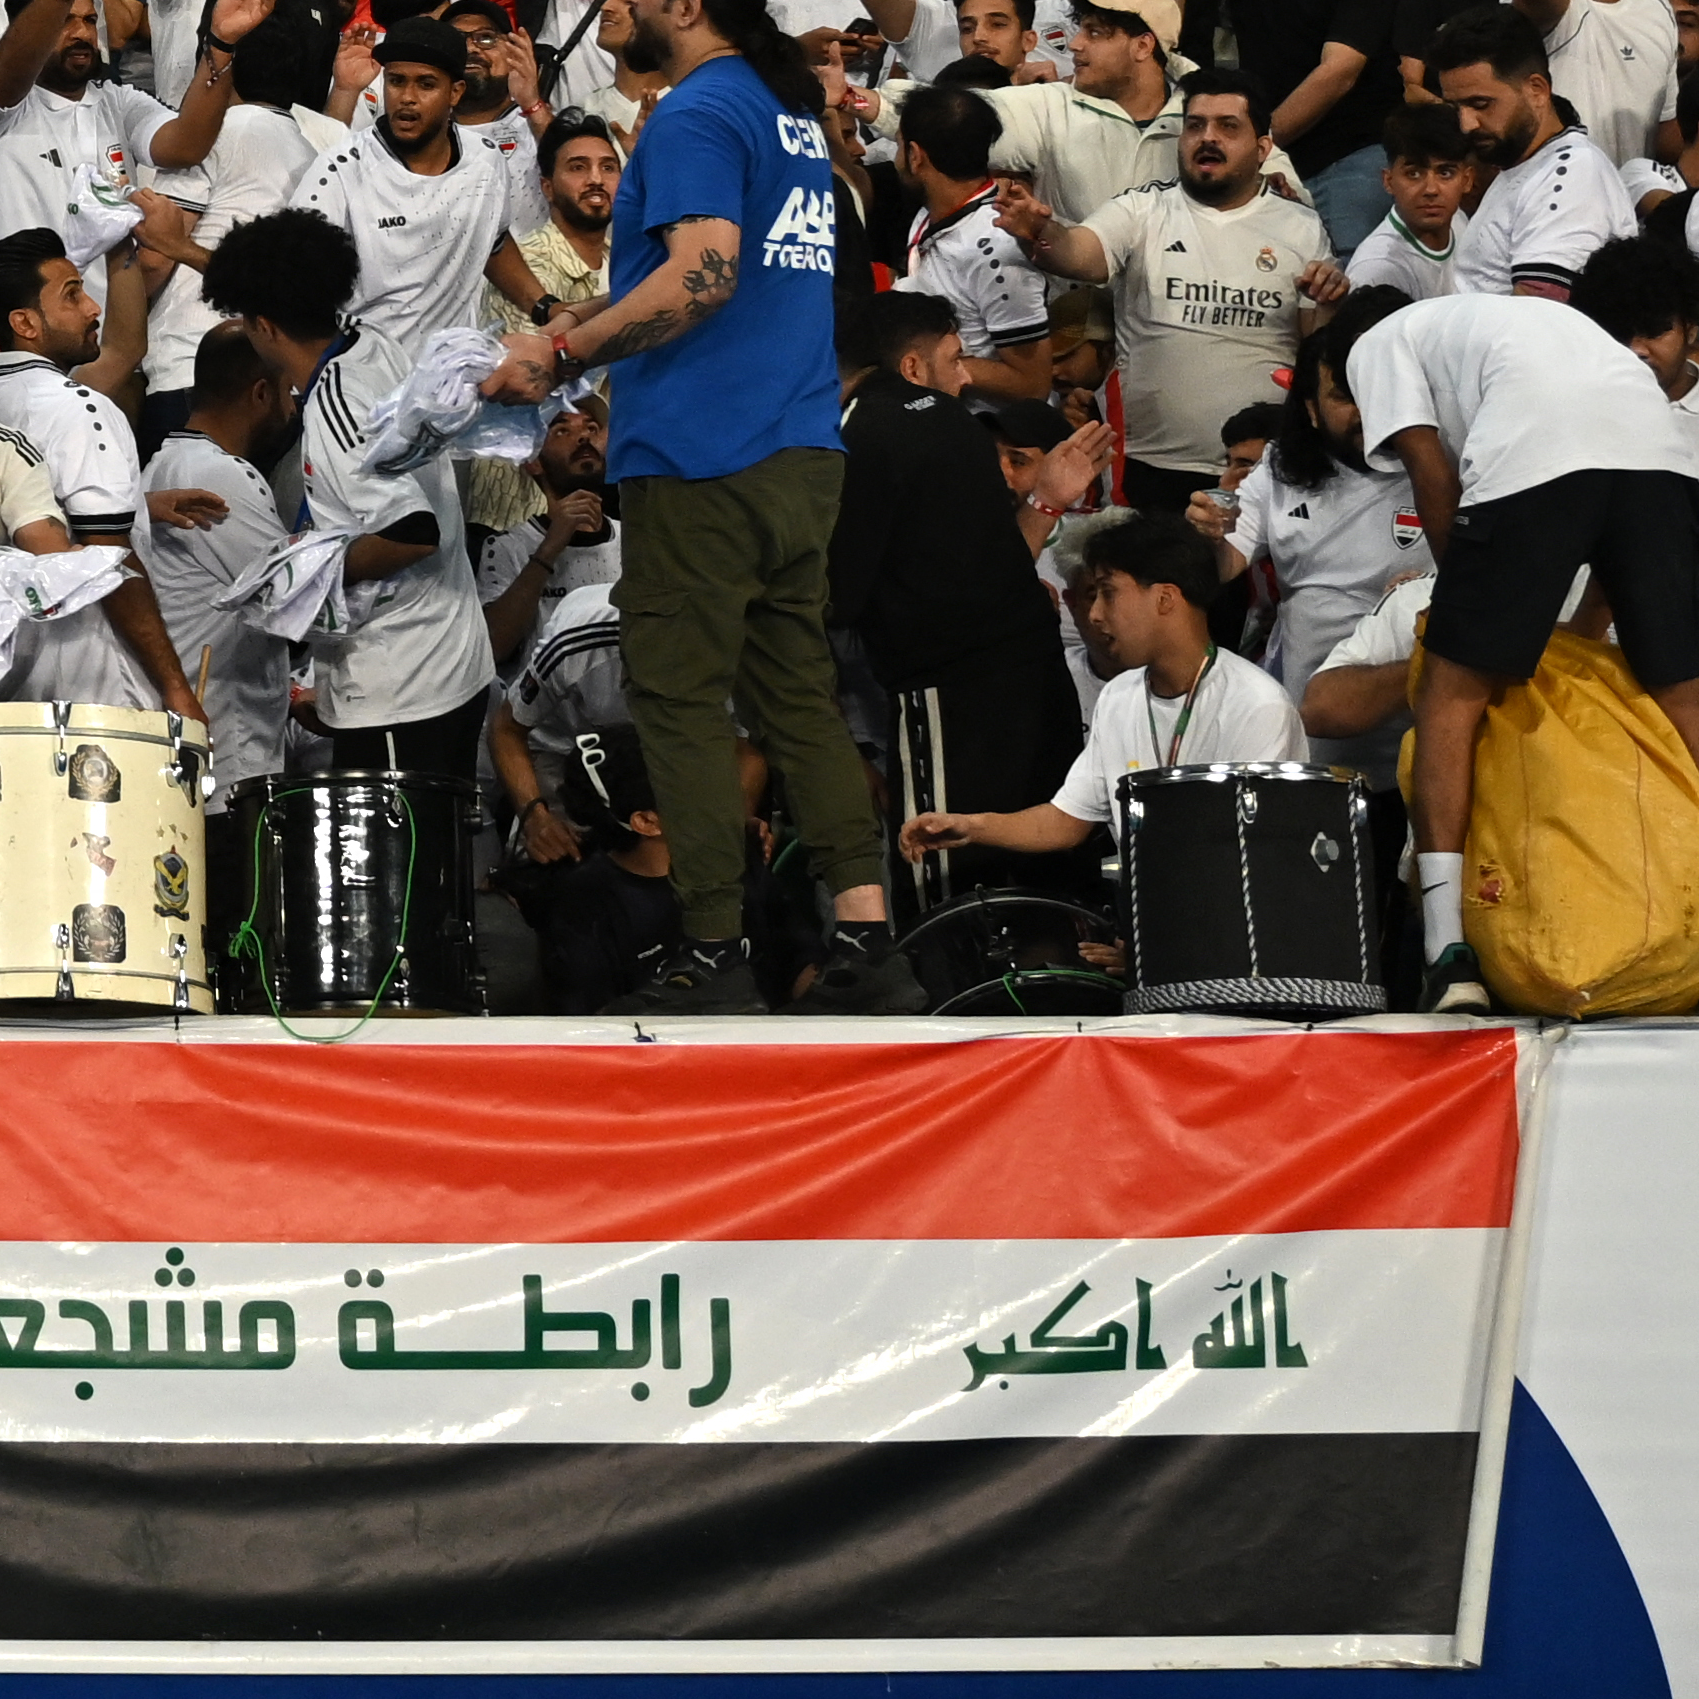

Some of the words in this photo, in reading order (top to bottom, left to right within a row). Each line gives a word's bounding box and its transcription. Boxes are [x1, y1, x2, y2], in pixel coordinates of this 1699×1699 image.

[378, 216, 406, 229] JAKO
[1166, 278, 1283, 308] Emirates
[1183, 305, 1208, 323] FLY
[1211, 308, 1266, 329] BETTER
[337, 1268, 733, 1408] رابطة
[960, 1277, 1167, 1391] اكبر
[1191, 1268, 1309, 1368] الله
